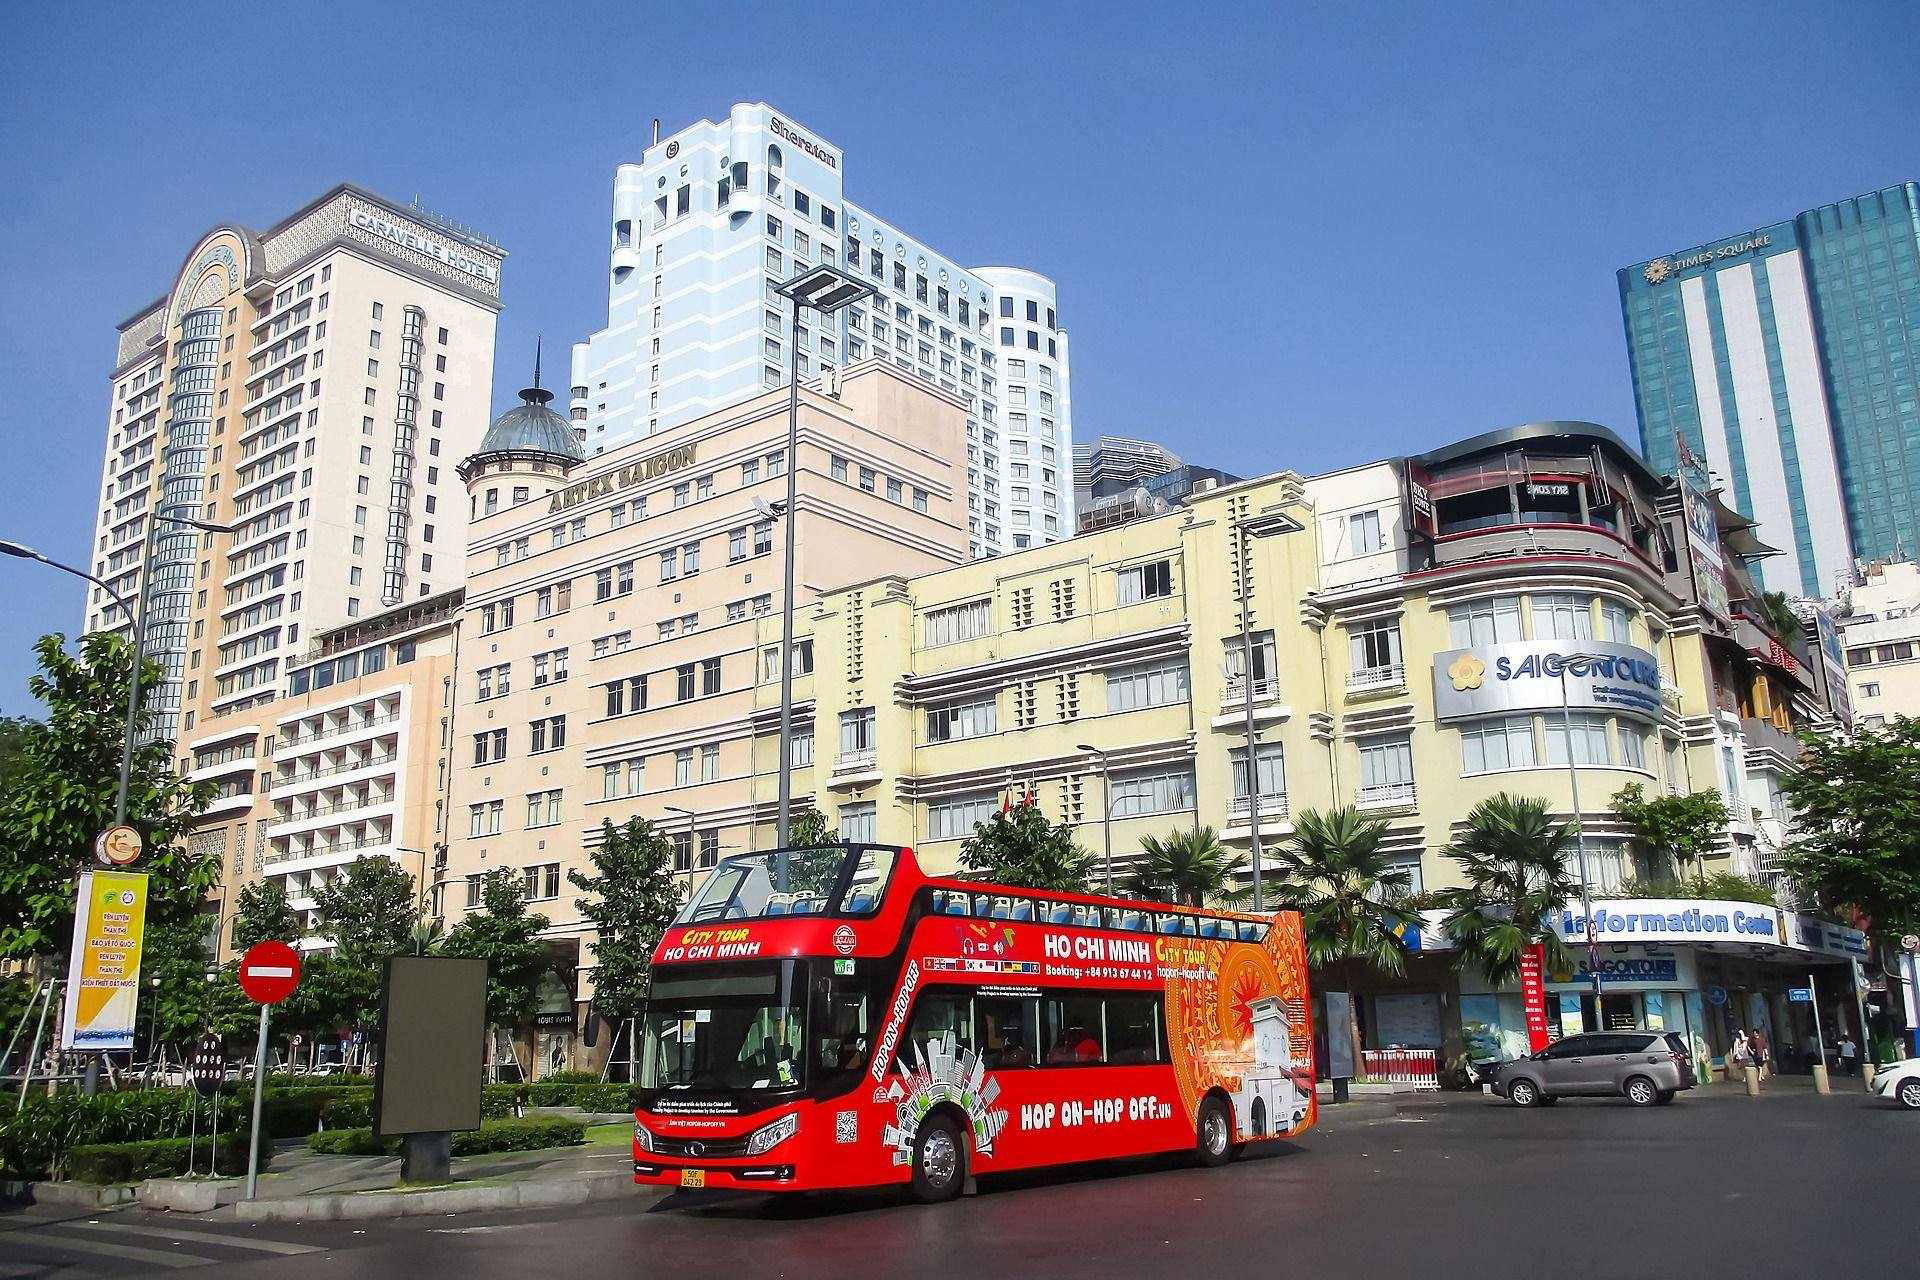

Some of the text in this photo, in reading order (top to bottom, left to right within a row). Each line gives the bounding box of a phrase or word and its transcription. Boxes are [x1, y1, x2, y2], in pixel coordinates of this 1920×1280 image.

[770, 116, 836, 170] Sheraton
[355, 212, 494, 281] CARAVELLE HOTEL
[1675, 234, 1771, 270] TIMES SQUARE
[548, 442, 698, 514] ARTEX SAIGON
[1412, 482, 1428, 501] SKY
[1413, 495, 1430, 512] ZONE
[1563, 909, 1729, 933] Information
[681, 928, 750, 945] CITY TOUR
[1044, 934, 1151, 963] HO CHI MINH
[664, 941, 761, 960] HO CHI MINH
[1155, 938, 1206, 965] CITY TOUR
[1045, 964, 1153, 980] Booking: +84 913 67 44 12
[1156, 964, 1218, 982] hopon-hopoff.vn
[1021, 1103, 1056, 1131] HOP
[1061, 1098, 1125, 1127] ON-HOP
